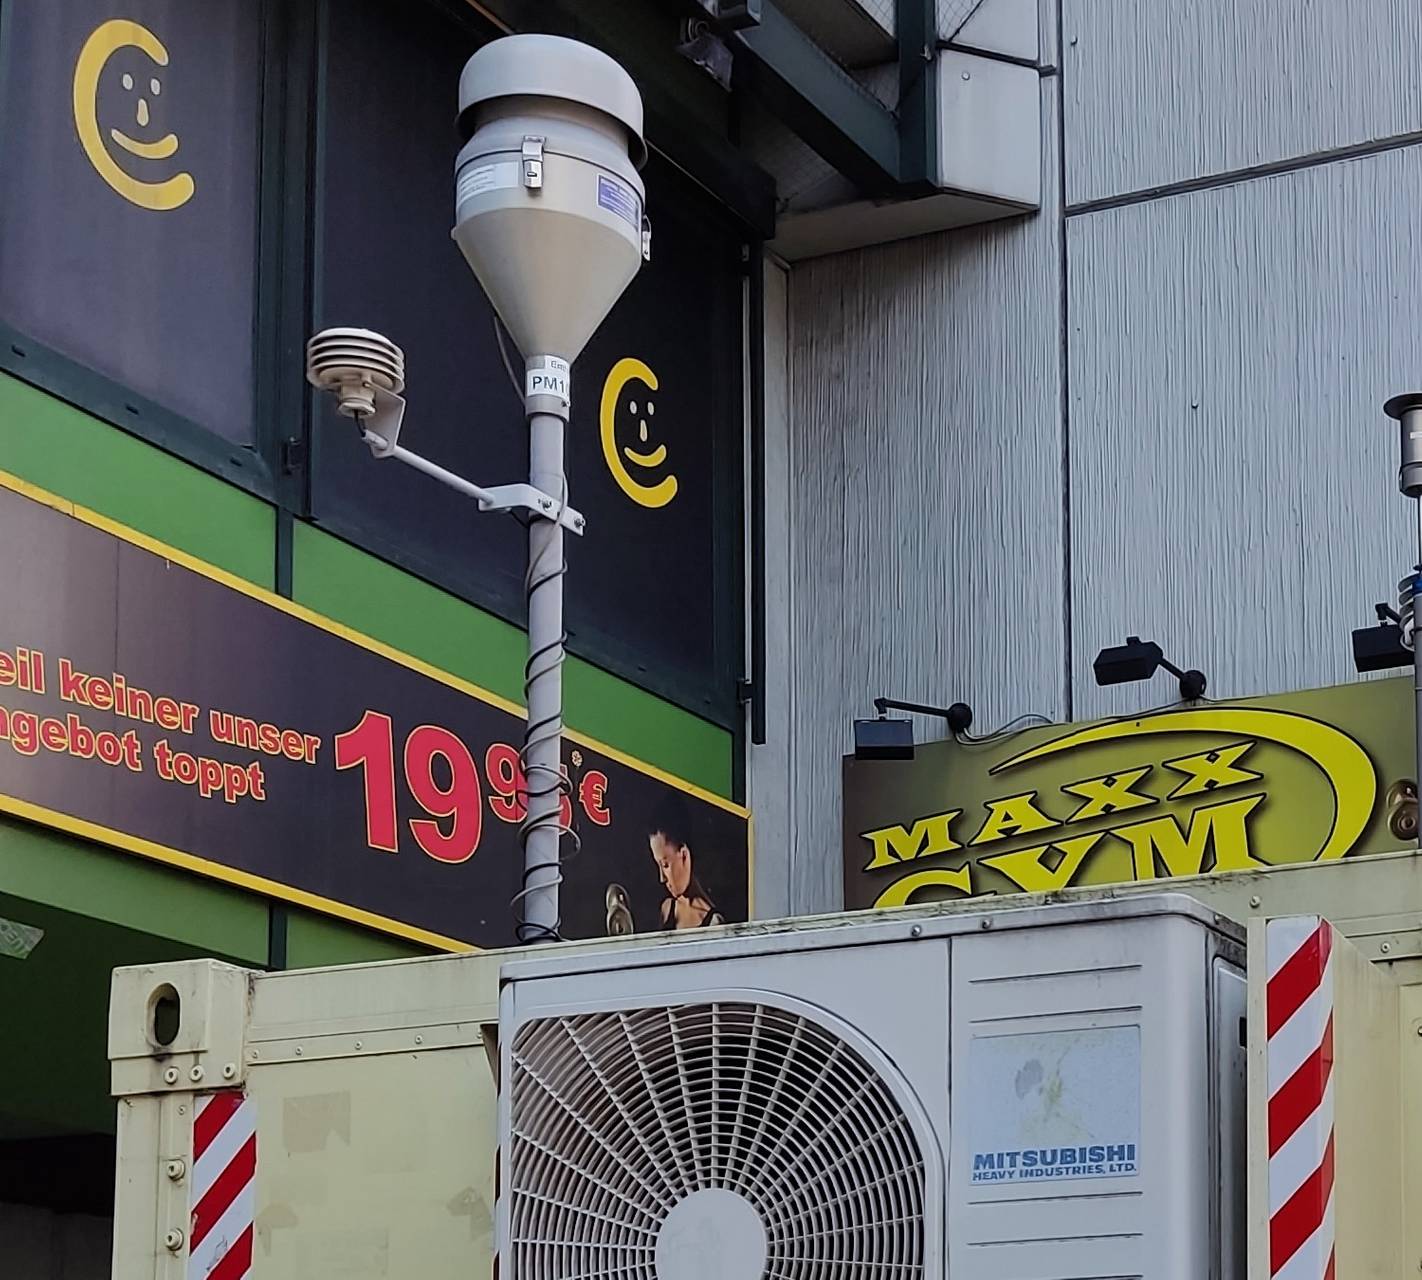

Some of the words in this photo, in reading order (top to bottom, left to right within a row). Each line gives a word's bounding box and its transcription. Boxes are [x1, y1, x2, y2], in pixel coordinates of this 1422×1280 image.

[532, 375, 569, 396] PM1
[58, 657, 200, 734] keiner
[209, 709, 321, 764] unser
[153, 738, 266, 803] toppt
[859, 740, 1265, 872] MAXX
[972, 1168, 1015, 1182] HEAVY
[1109, 1162, 1137, 1173] LTD.
[973, 1144, 1136, 1171] MITSUBISHI
